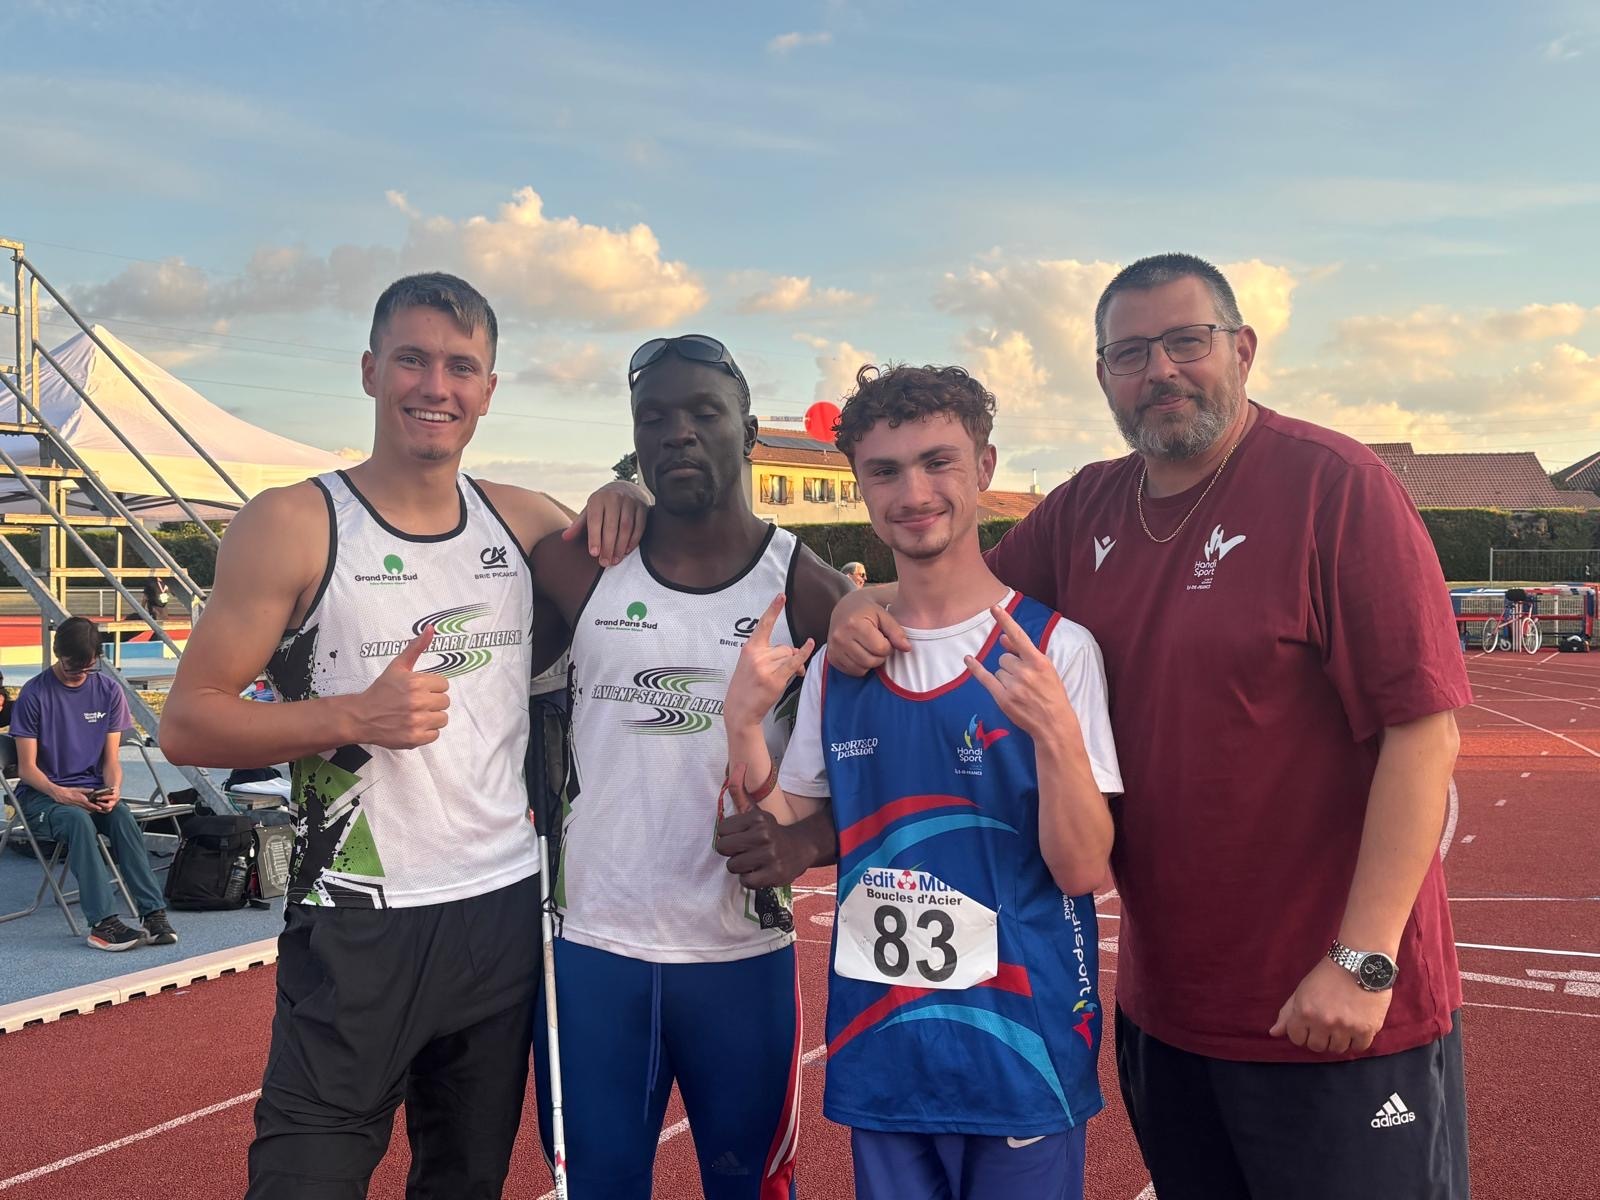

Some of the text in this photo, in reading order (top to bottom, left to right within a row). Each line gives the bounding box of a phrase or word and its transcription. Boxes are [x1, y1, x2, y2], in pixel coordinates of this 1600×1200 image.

[1194, 559, 1217, 569] Handi
[1194, 567, 1215, 577] Sport
[354, 574, 381, 582] Grand
[402, 573, 418, 581] Sud
[619, 619, 641, 628] Paris
[641, 621, 658, 630] Sud
[719, 639, 739, 647] BRIE
[836, 747, 875, 762] passion
[956, 747, 983, 756] Handi
[959, 754, 983, 763] Sport
[919, 874, 955, 892] Mu
[866, 888, 963, 906] Boucles d'Acier
[873, 904, 958, 983] 83
[1370, 1111, 1416, 1128] adidas
